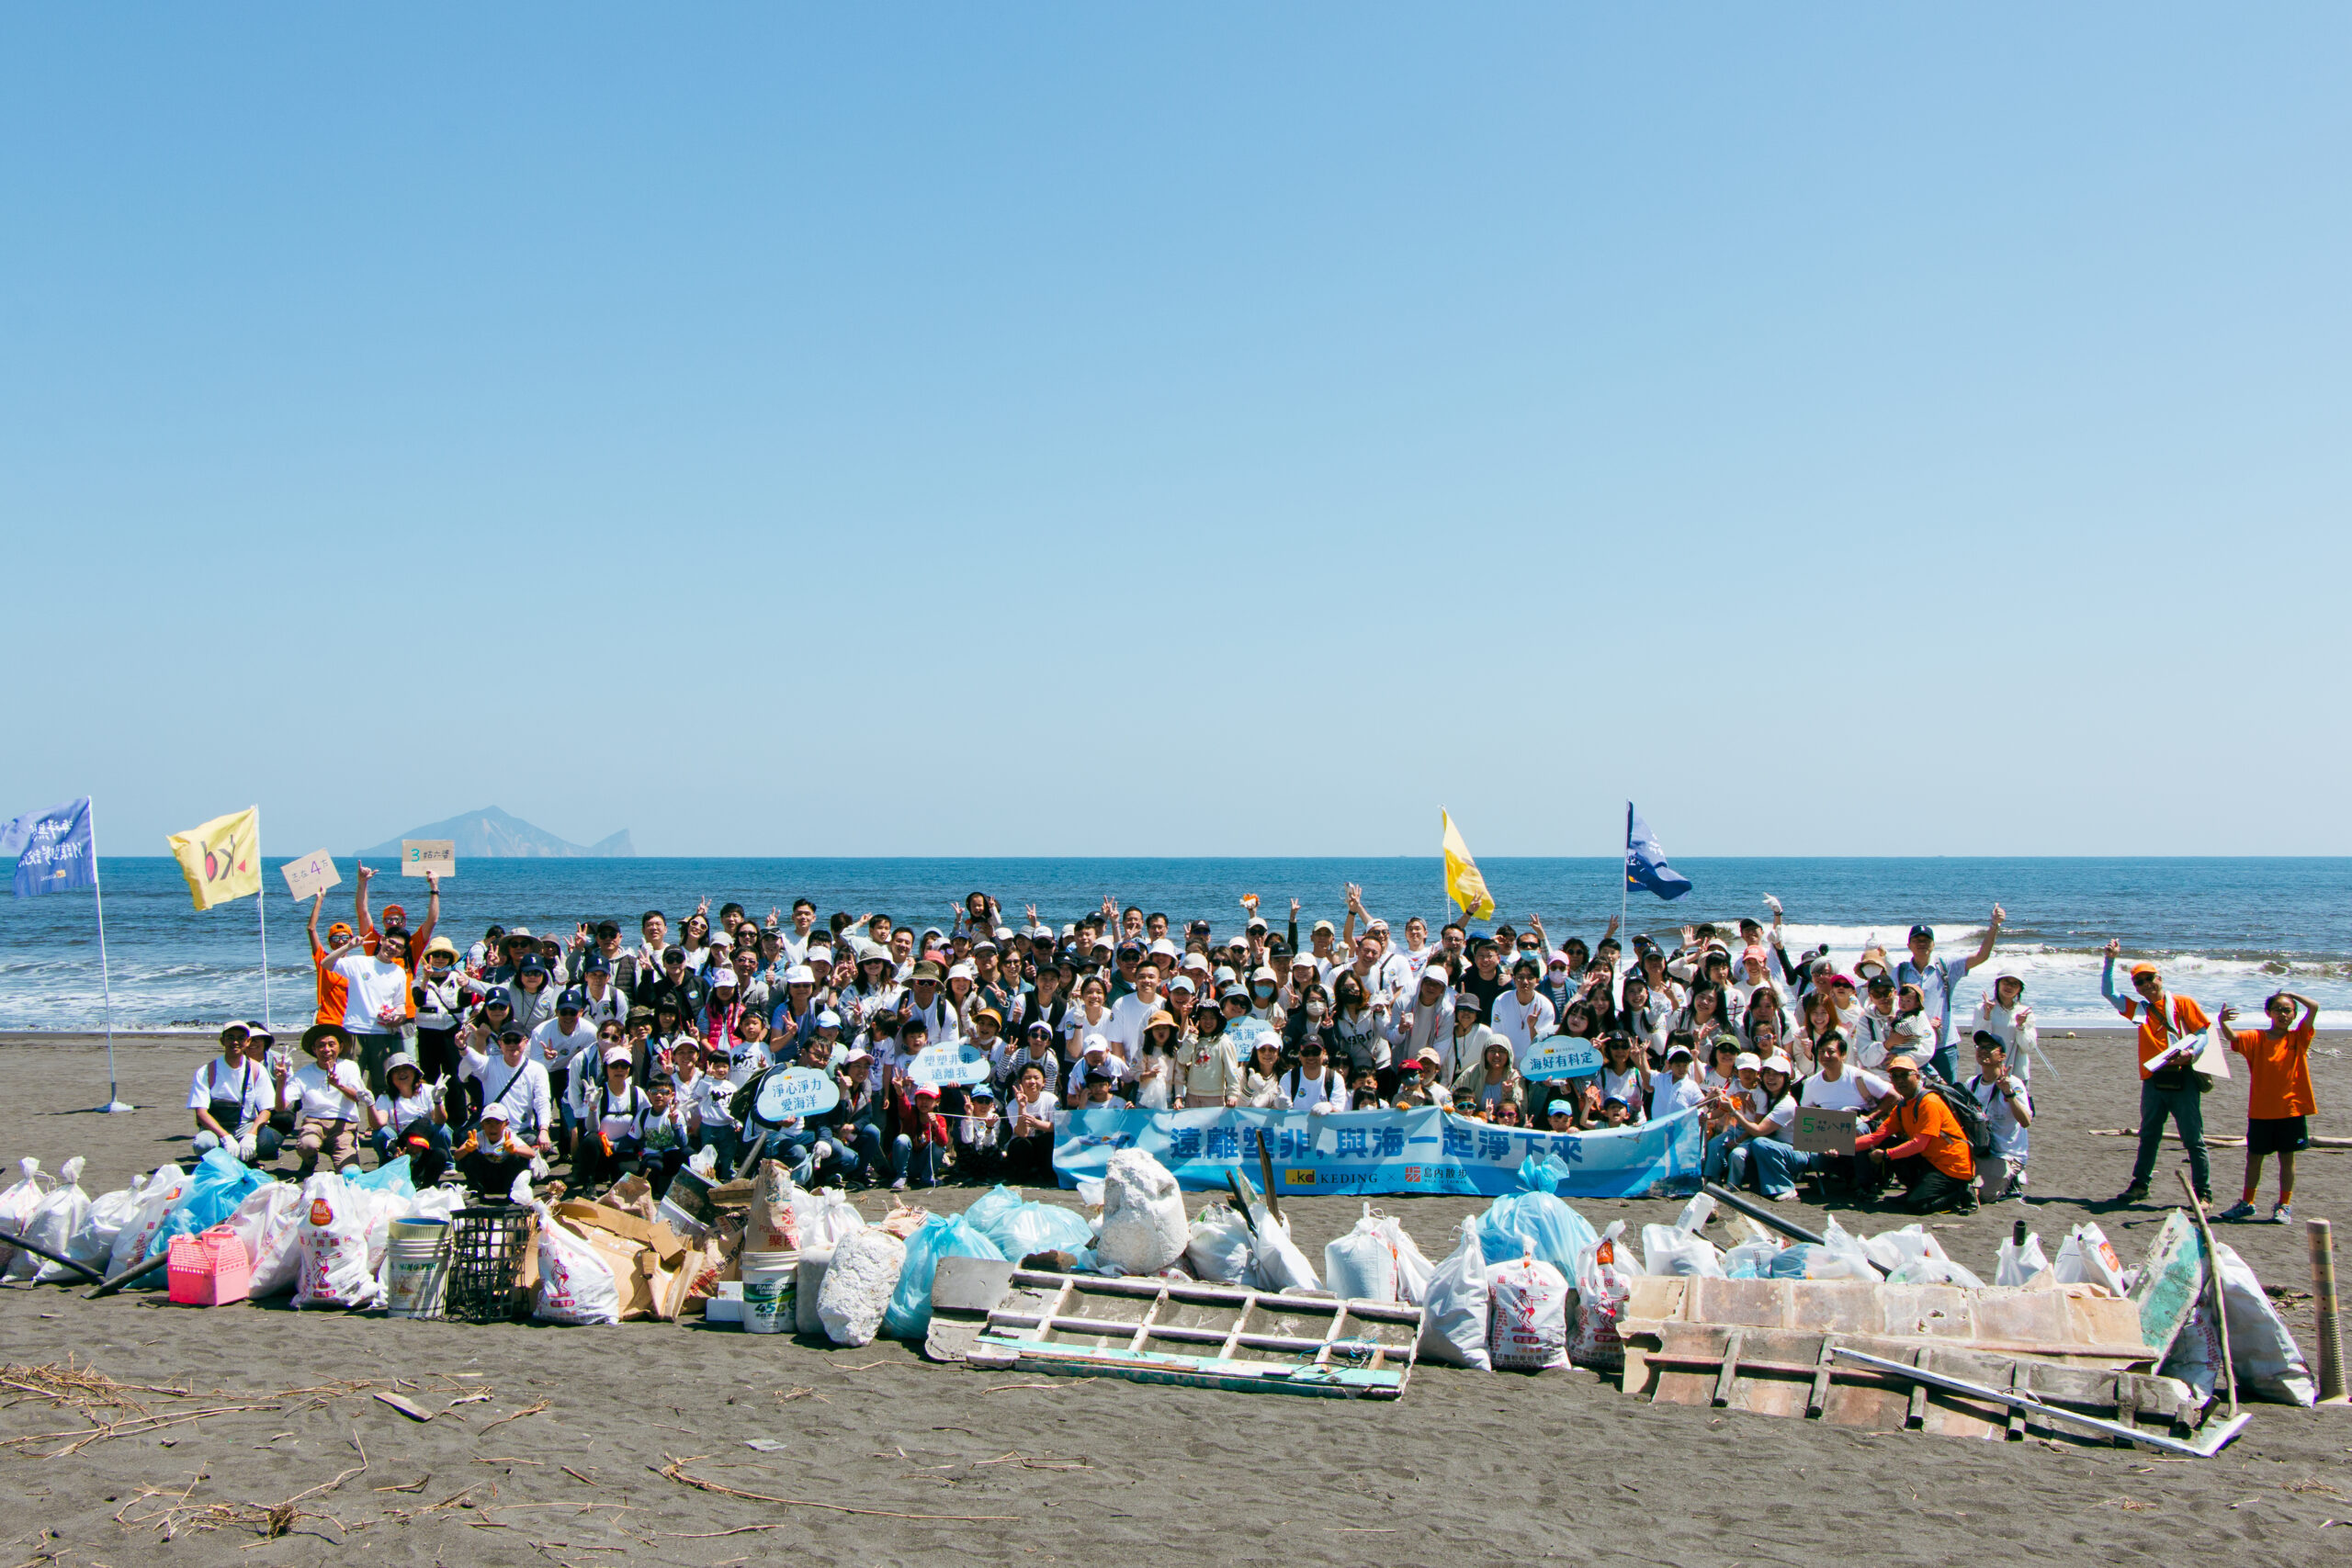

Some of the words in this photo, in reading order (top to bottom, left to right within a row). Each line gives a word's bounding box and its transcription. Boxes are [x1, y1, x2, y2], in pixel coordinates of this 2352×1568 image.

[924, 1052, 973, 1066] 塑塑非非
[1529, 1051, 1593, 1070] 海好有科定
[931, 1067, 967, 1079] 遠離我
[772, 1077, 821, 1097] 淨心淨力
[781, 1094, 816, 1112] 愛海洋
[1802, 1117, 1851, 1134] 5花八門
[1320, 1173, 1377, 1184] KEDING
[1424, 1167, 1467, 1179] 島內散步
